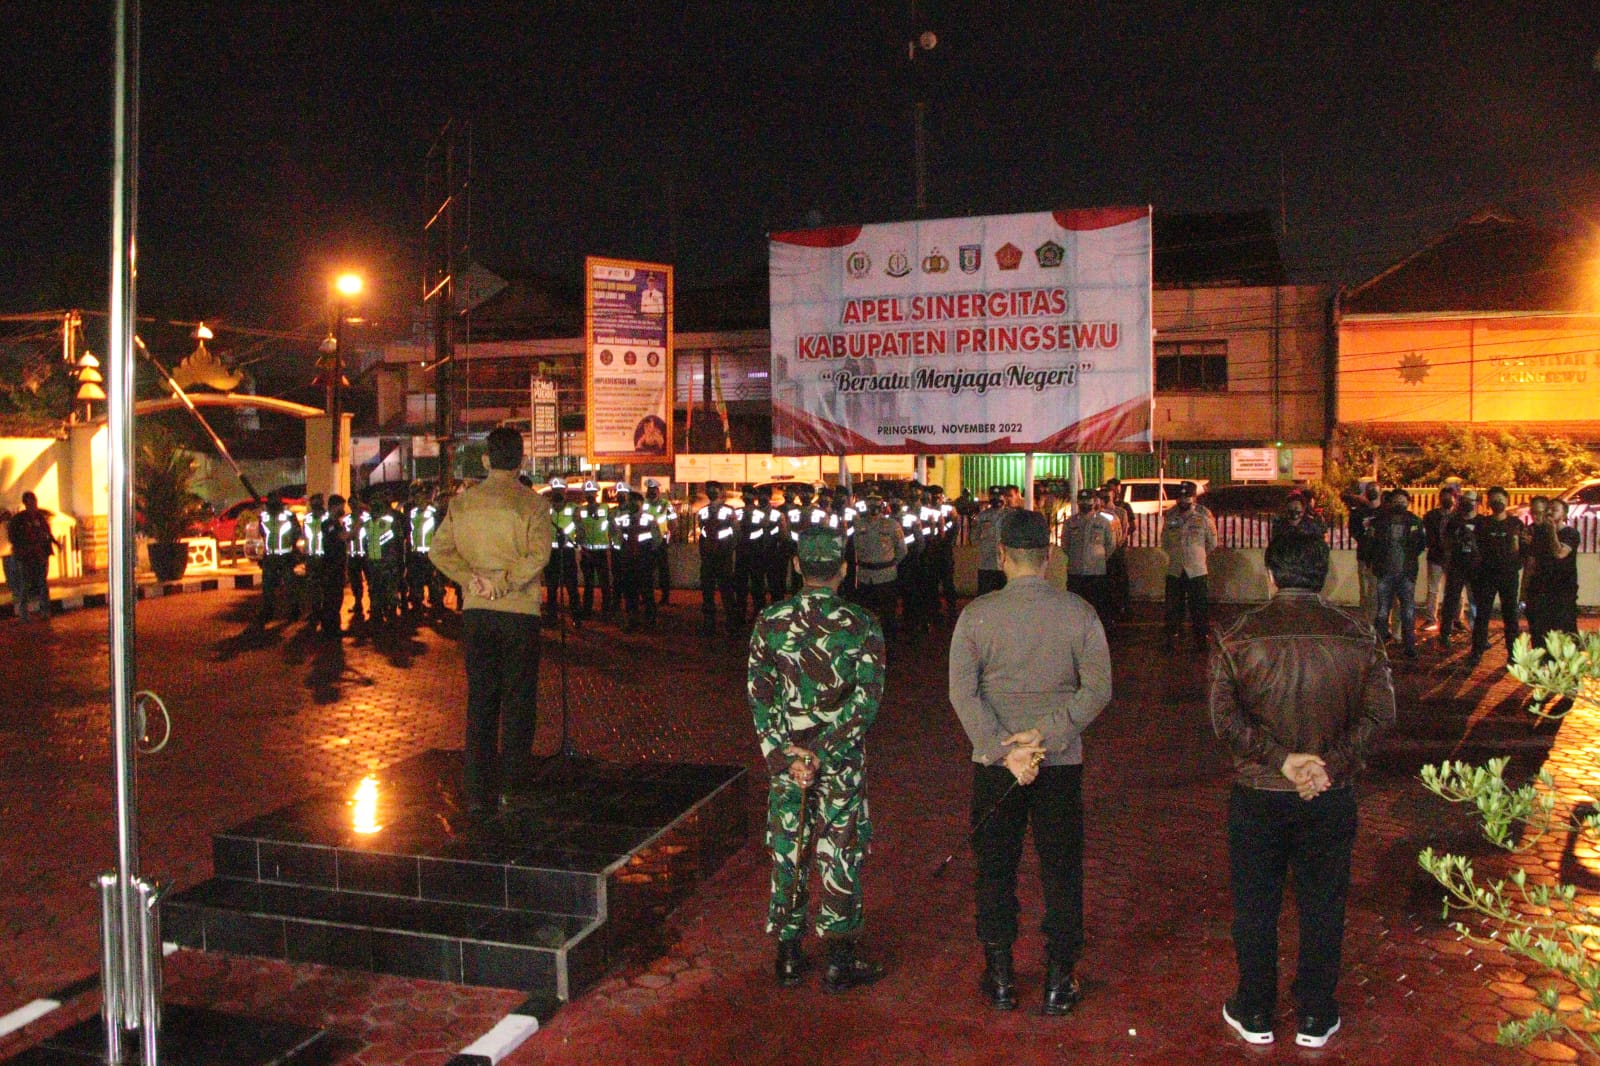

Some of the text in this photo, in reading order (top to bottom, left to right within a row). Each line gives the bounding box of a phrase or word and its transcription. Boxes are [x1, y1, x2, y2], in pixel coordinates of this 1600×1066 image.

[844, 289, 1066, 324] APEL SINERGITAS
[799, 323, 1118, 360] KABUPATEN PRINGSEWU
[917, 368, 1001, 394] Menjaga
[877, 423, 1023, 436] PRINGSEWU, NOVEMBER 2022
